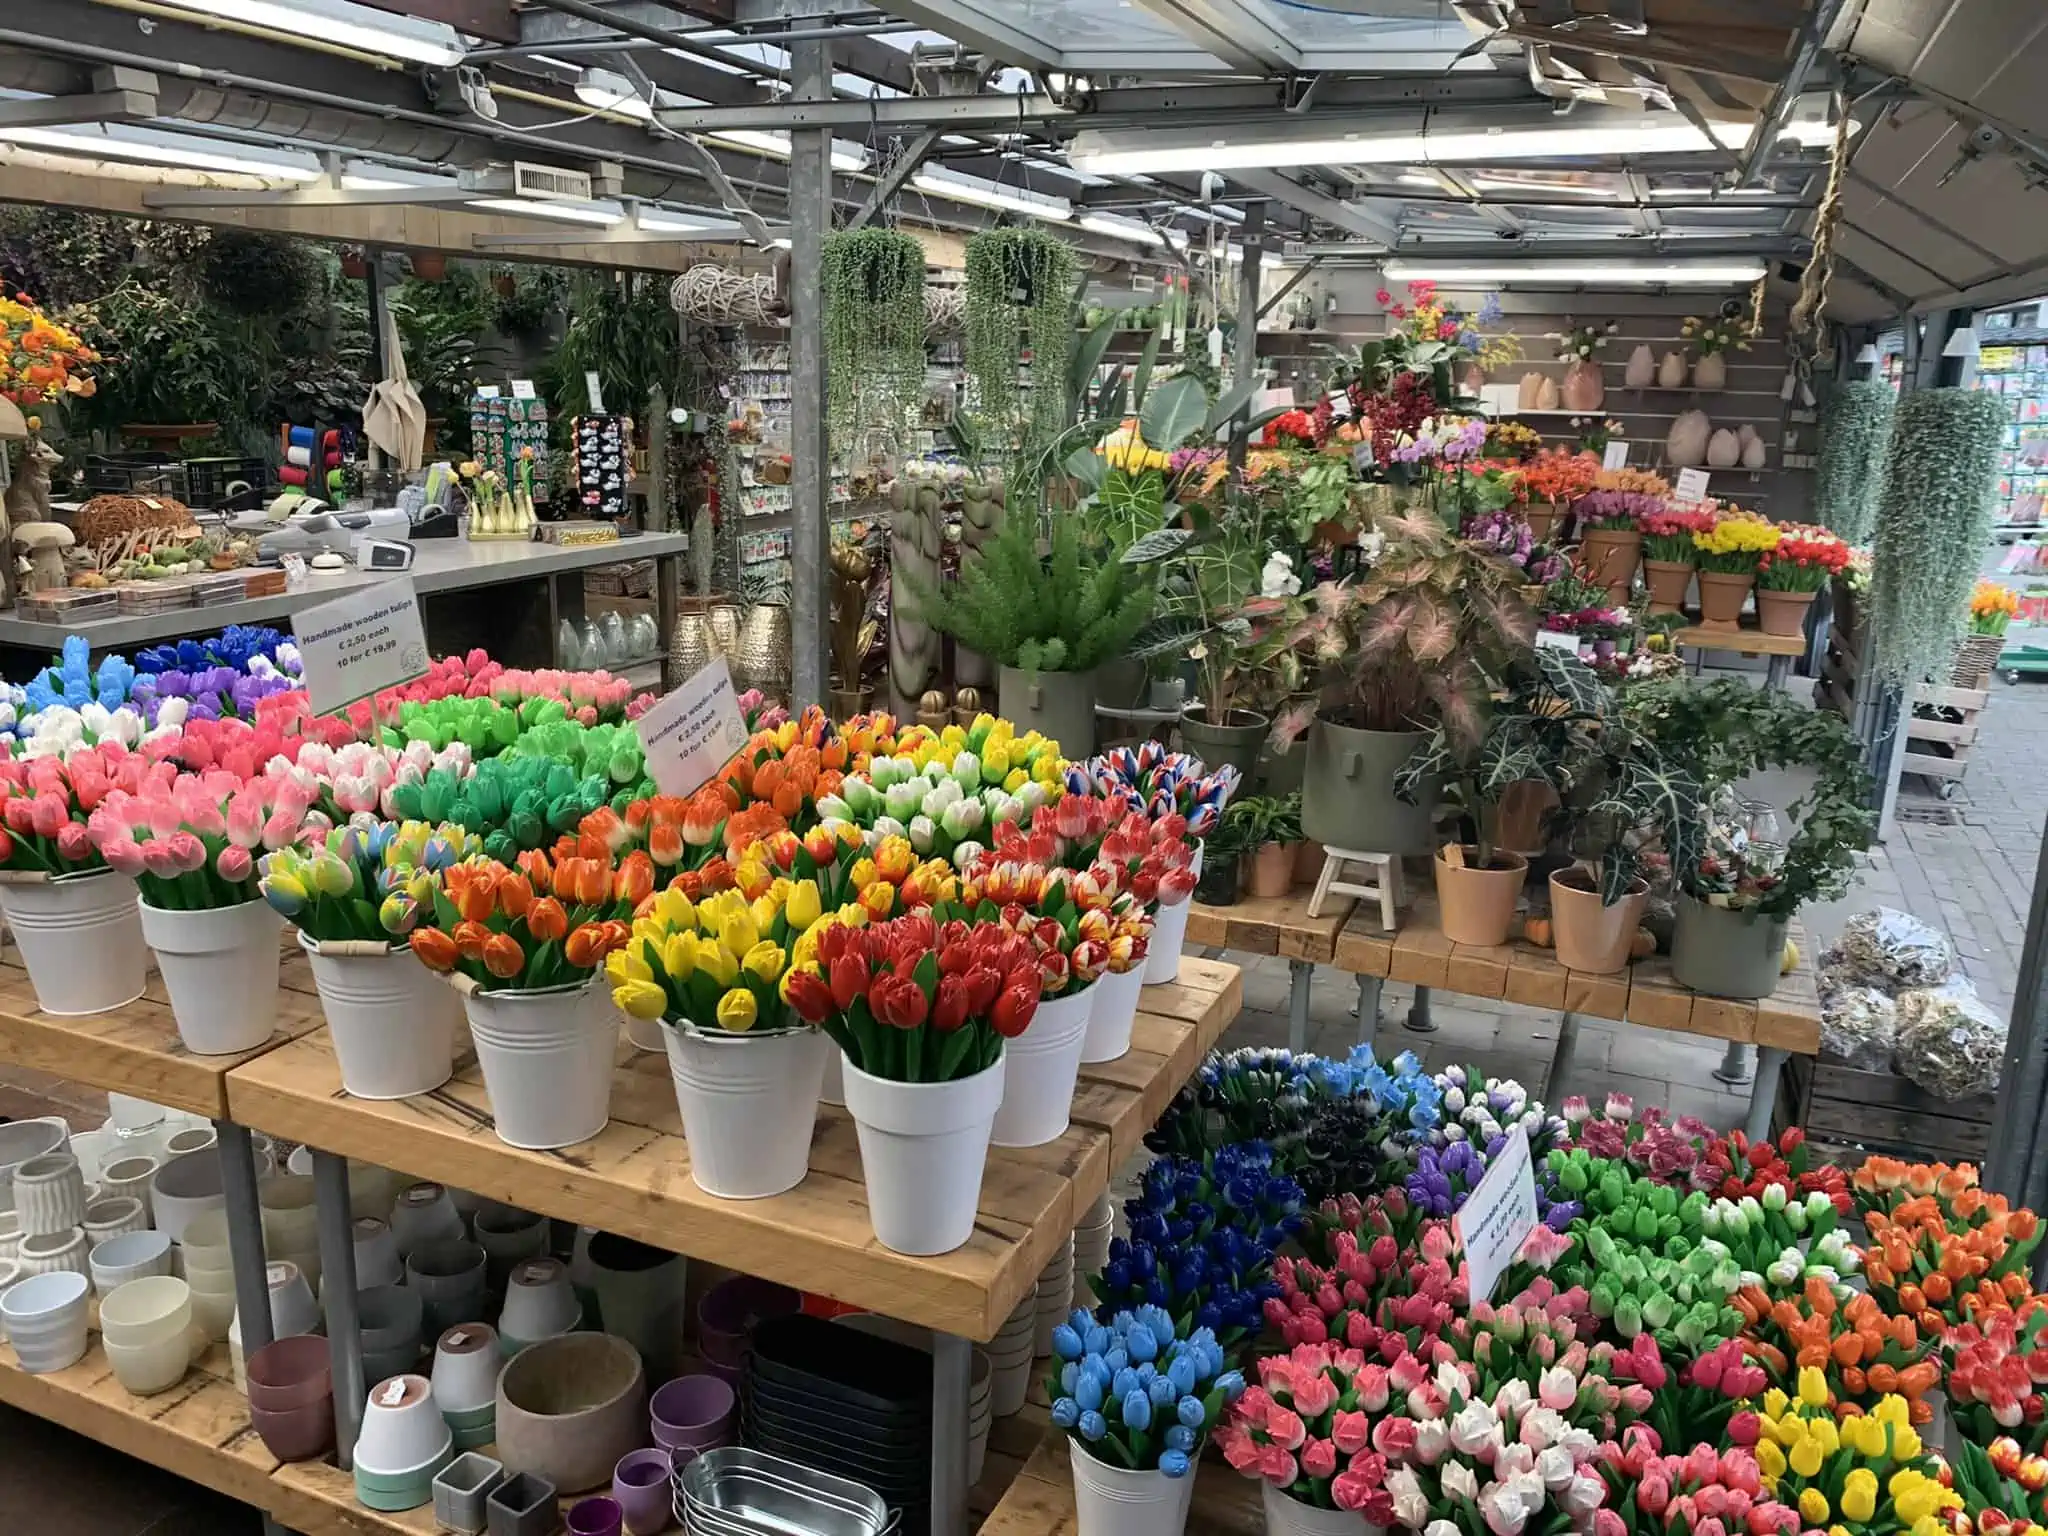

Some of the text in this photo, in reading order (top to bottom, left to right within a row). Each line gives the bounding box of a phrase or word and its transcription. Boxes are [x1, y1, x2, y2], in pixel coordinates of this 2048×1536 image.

[303, 599, 412, 645] Handmade wooden tulips
[338, 626, 390, 650] € 2,50 each
[338, 657, 348, 669] 10
[350, 652, 362, 663] for
[365, 648, 371, 657] €
[648, 714, 687, 746] Handmade
[679, 750, 688, 760] 10
[1468, 1204, 1499, 1248] Handmade
